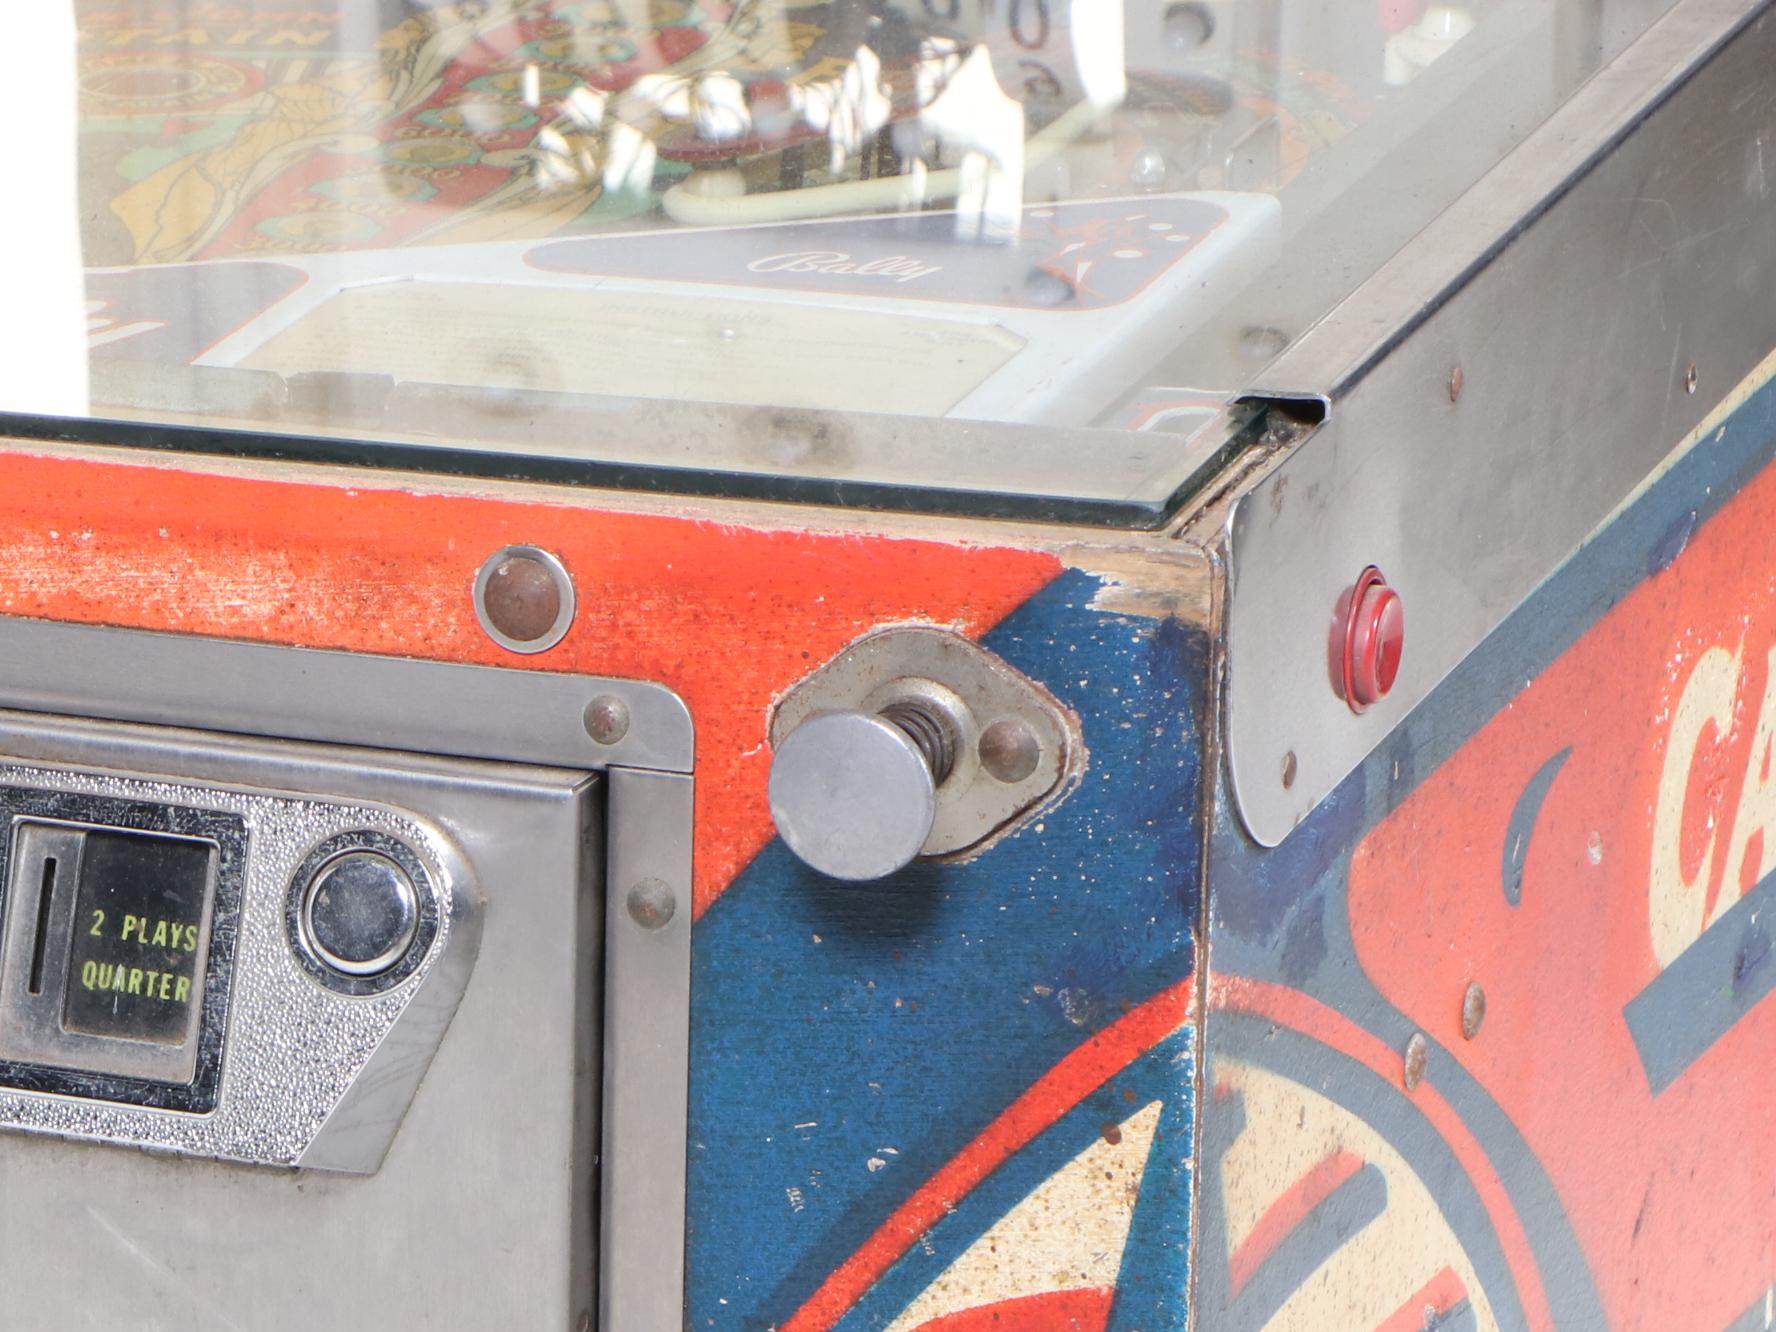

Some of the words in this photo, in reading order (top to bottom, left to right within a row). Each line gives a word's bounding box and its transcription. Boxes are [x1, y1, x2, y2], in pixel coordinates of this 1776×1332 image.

[746, 251, 944, 283] Bally
[90, 909, 105, 936] 2
[121, 914, 198, 952] PLAYS
[82, 960, 191, 1003] QUARTER
